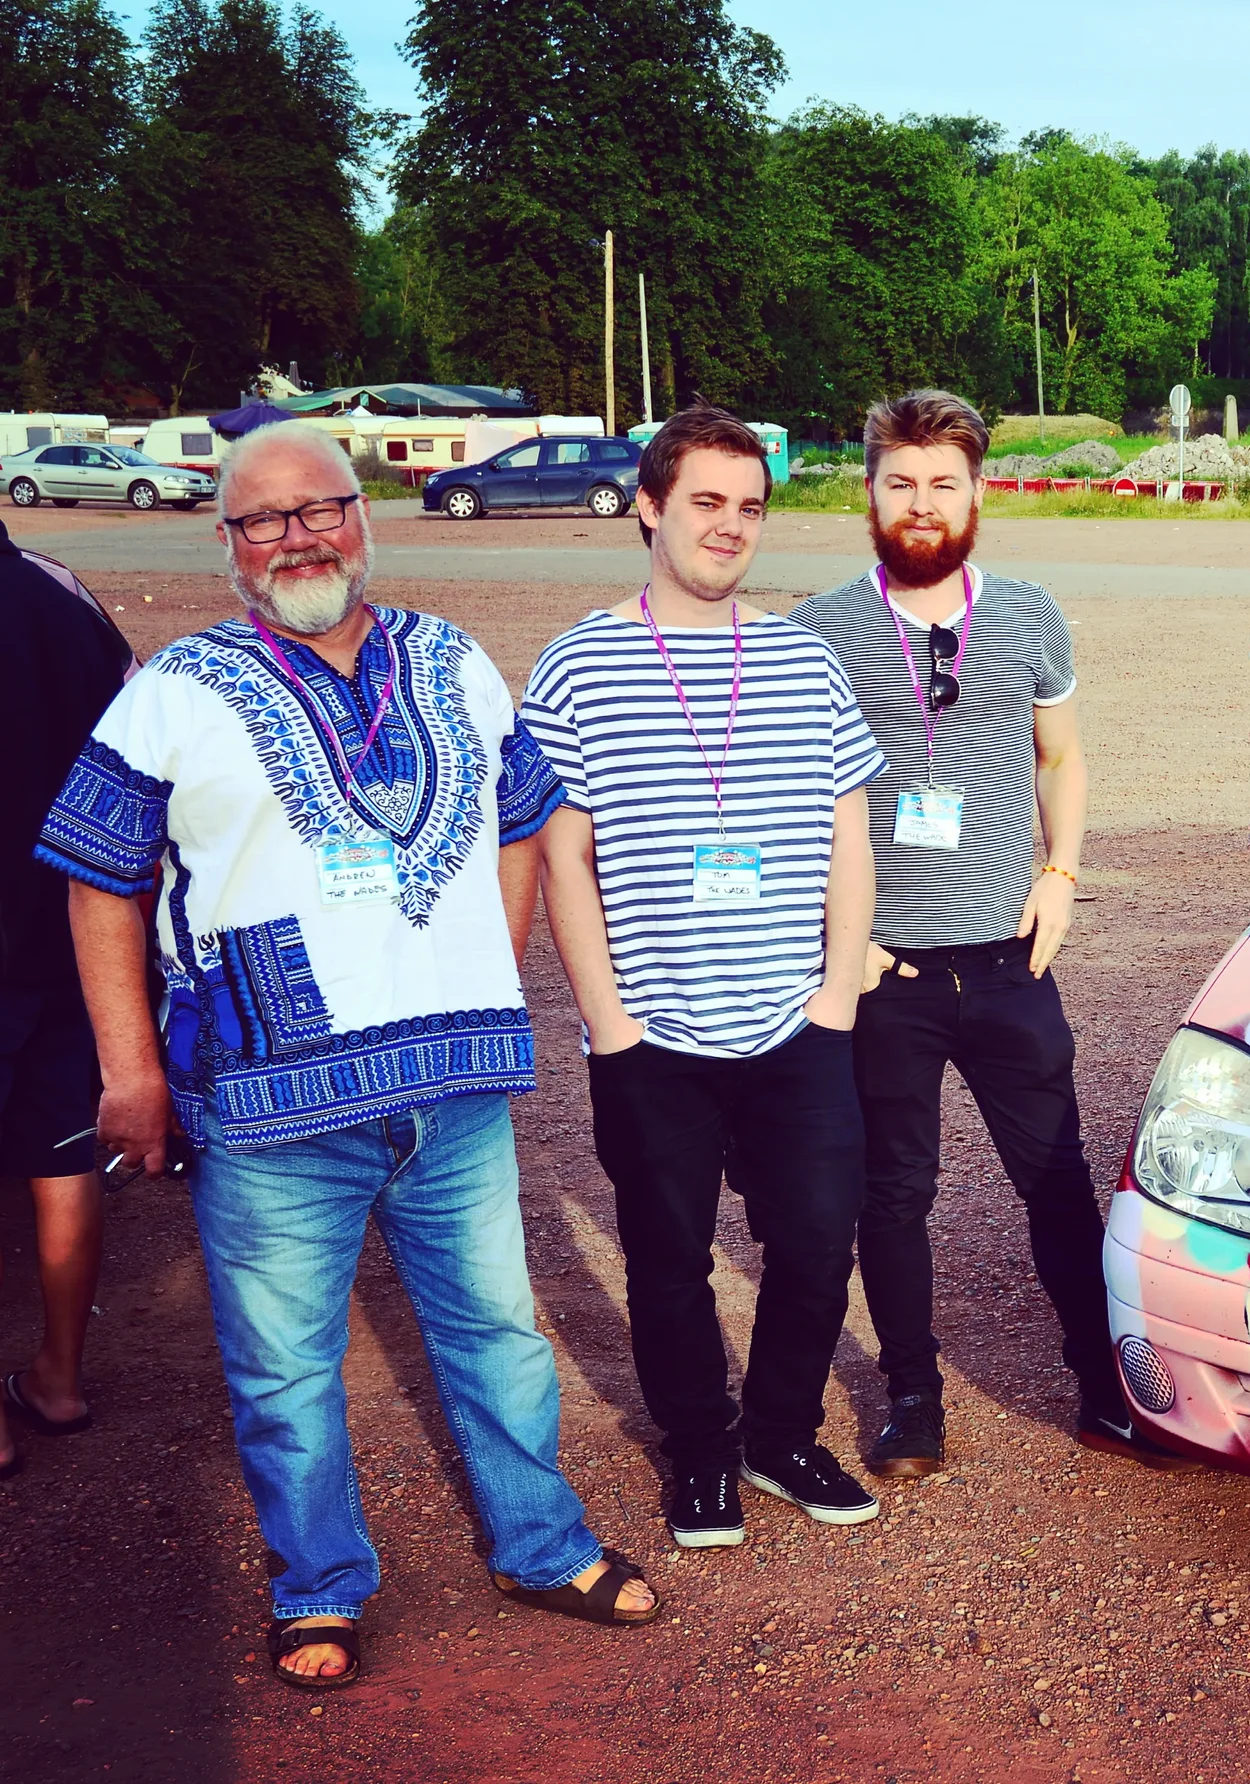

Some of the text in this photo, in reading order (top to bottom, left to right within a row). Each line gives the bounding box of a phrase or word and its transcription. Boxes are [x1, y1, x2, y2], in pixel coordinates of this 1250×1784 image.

[901, 832, 921, 841] THE
[713, 871, 731, 879] TOM
[326, 889, 347, 899] THE
